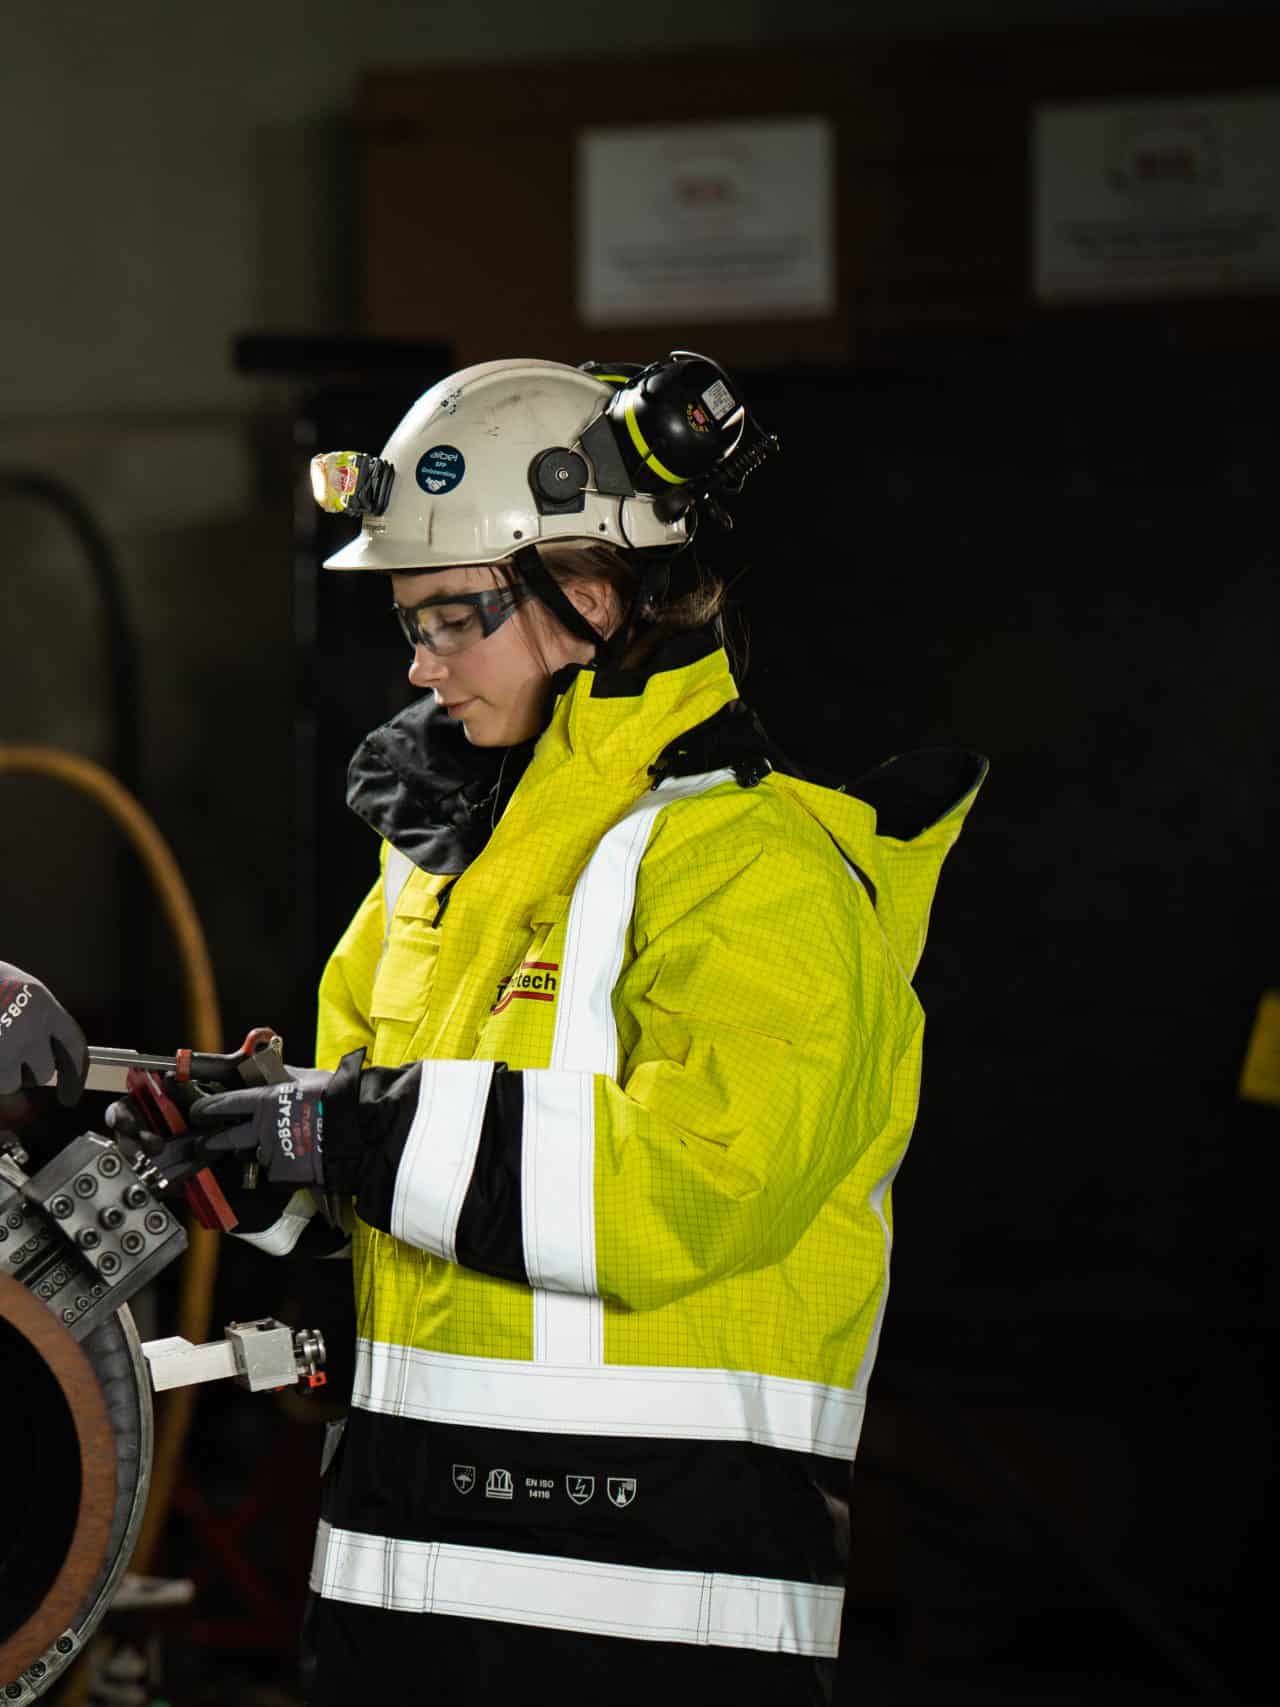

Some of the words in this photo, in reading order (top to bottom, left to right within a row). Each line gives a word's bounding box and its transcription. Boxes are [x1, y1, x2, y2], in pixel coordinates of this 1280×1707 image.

[277, 1083, 296, 1160] JOBSAFE
[525, 1478, 538, 1488] EN
[539, 1479, 554, 1489] ISO
